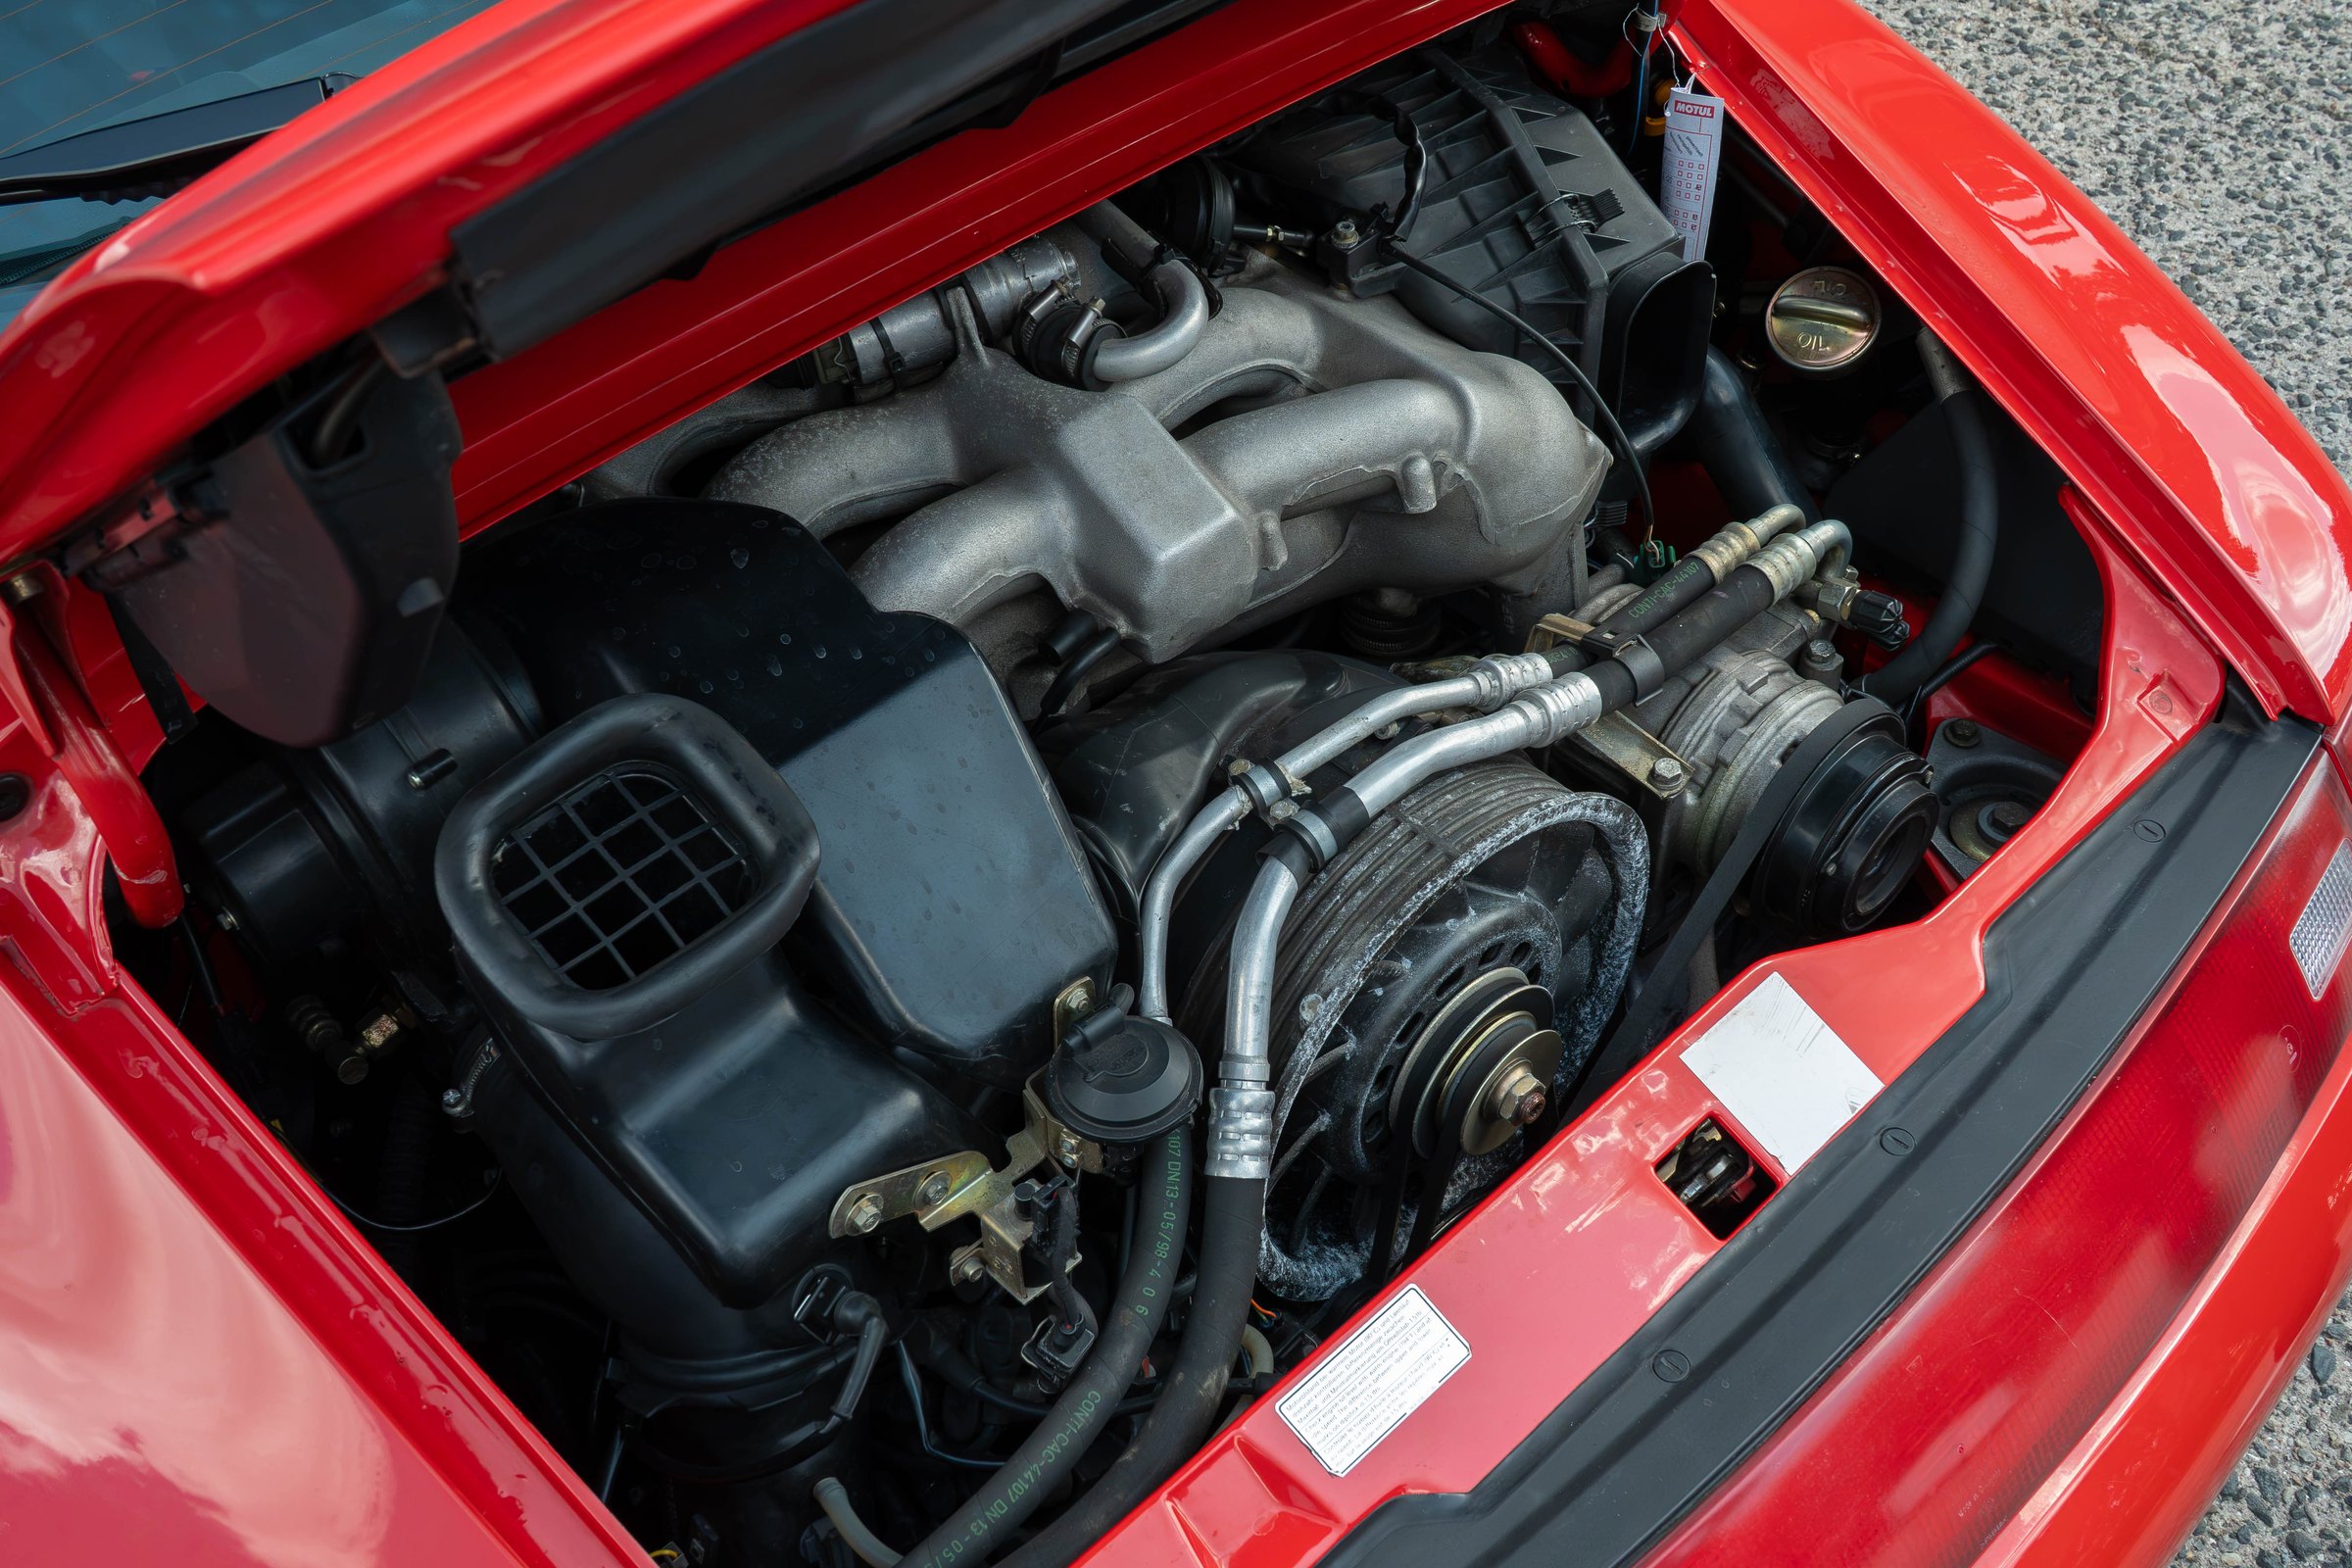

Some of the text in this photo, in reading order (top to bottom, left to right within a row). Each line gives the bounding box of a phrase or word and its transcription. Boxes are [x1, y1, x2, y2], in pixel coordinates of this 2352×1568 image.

[1676, 102, 1713, 117] MOTUL
[1797, 331, 1830, 351] OIL
[1628, 561, 1700, 618] CONTI-CAC-44107
[1007, 1390, 1102, 1503] CONTI-CAC-44107
